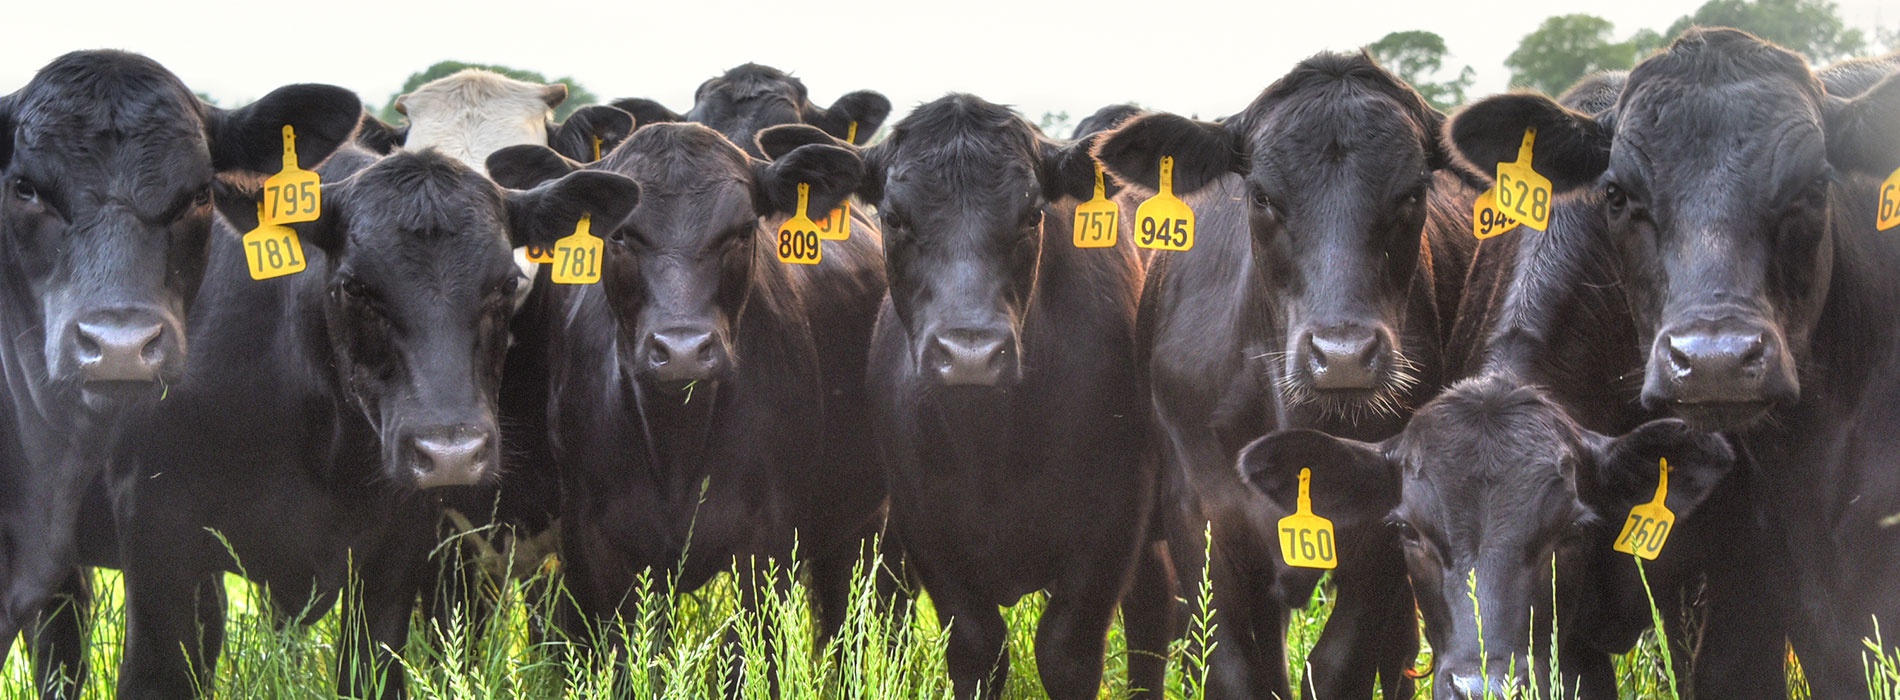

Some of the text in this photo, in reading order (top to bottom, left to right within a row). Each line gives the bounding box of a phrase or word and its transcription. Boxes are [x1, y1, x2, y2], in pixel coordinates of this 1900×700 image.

[267, 181, 316, 218] 795
[1500, 173, 1548, 223] 628
[1078, 211, 1115, 241] 757
[1141, 216, 1188, 247] 945
[1480, 207, 1516, 235] 94
[248, 236, 300, 272] 781
[779, 229, 819, 260] 809
[558, 247, 597, 277] 781
[1282, 527, 1333, 562] 760
[1620, 514, 1669, 552] 760
